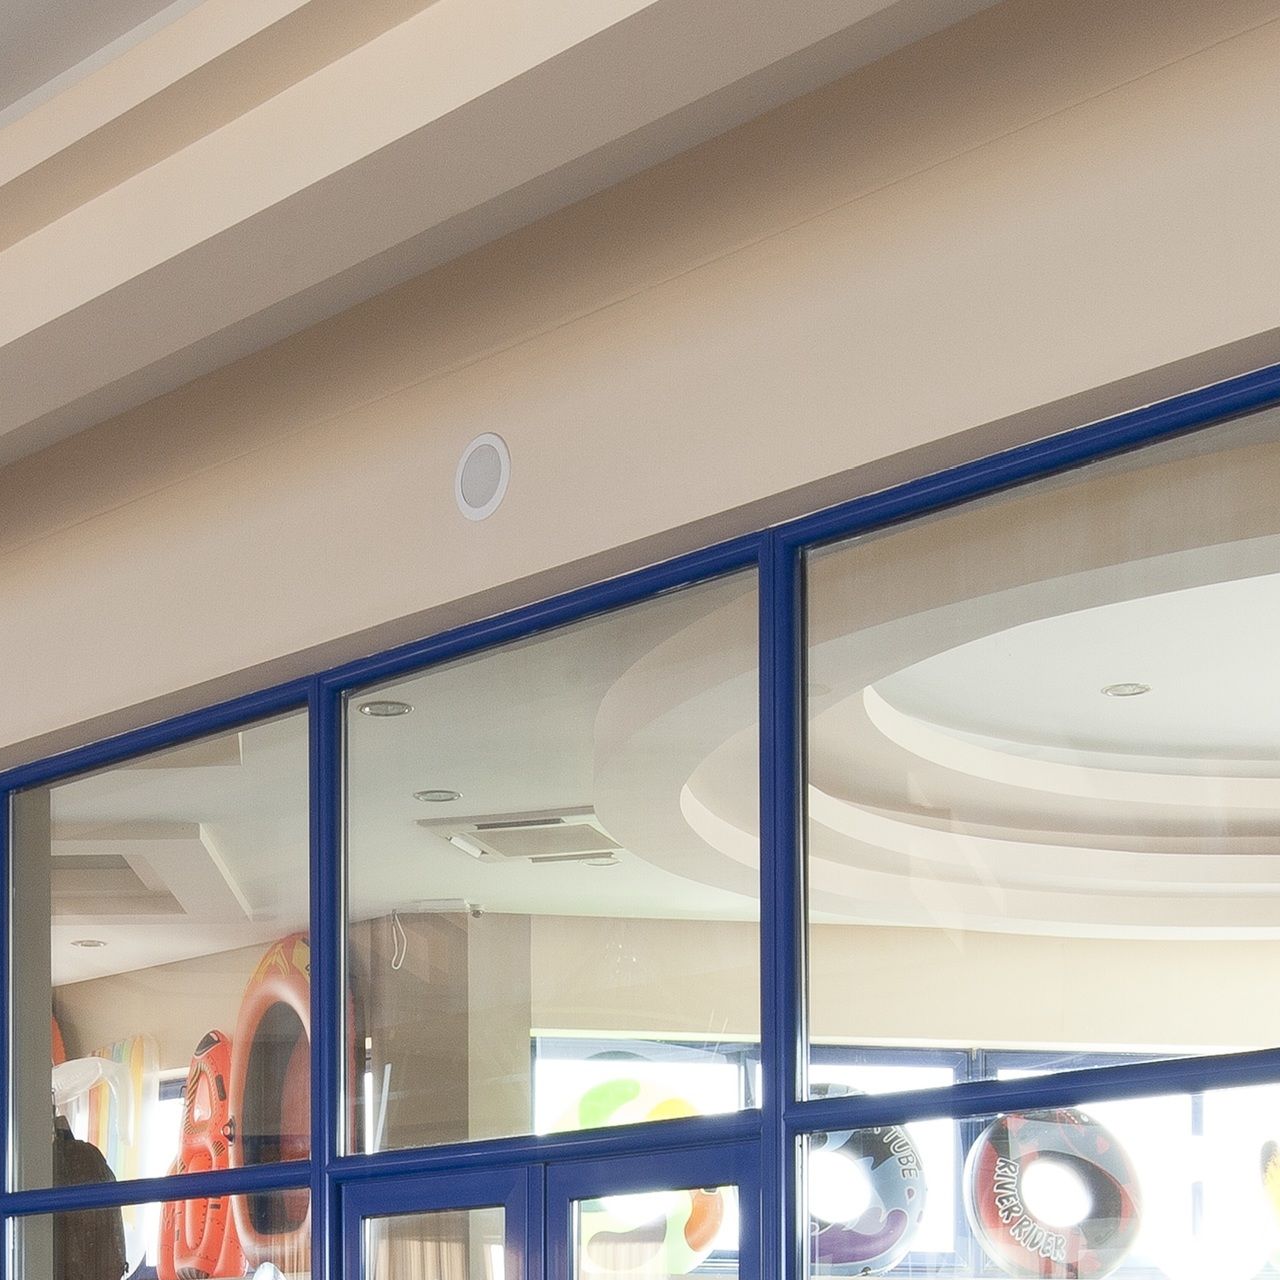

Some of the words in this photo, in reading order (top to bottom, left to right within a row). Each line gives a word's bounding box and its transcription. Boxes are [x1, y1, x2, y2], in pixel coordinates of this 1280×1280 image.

[882, 1124, 919, 1180] TUBE
[993, 1157, 1023, 1224] RIVER
[1010, 1215, 1067, 1261] RIDER
